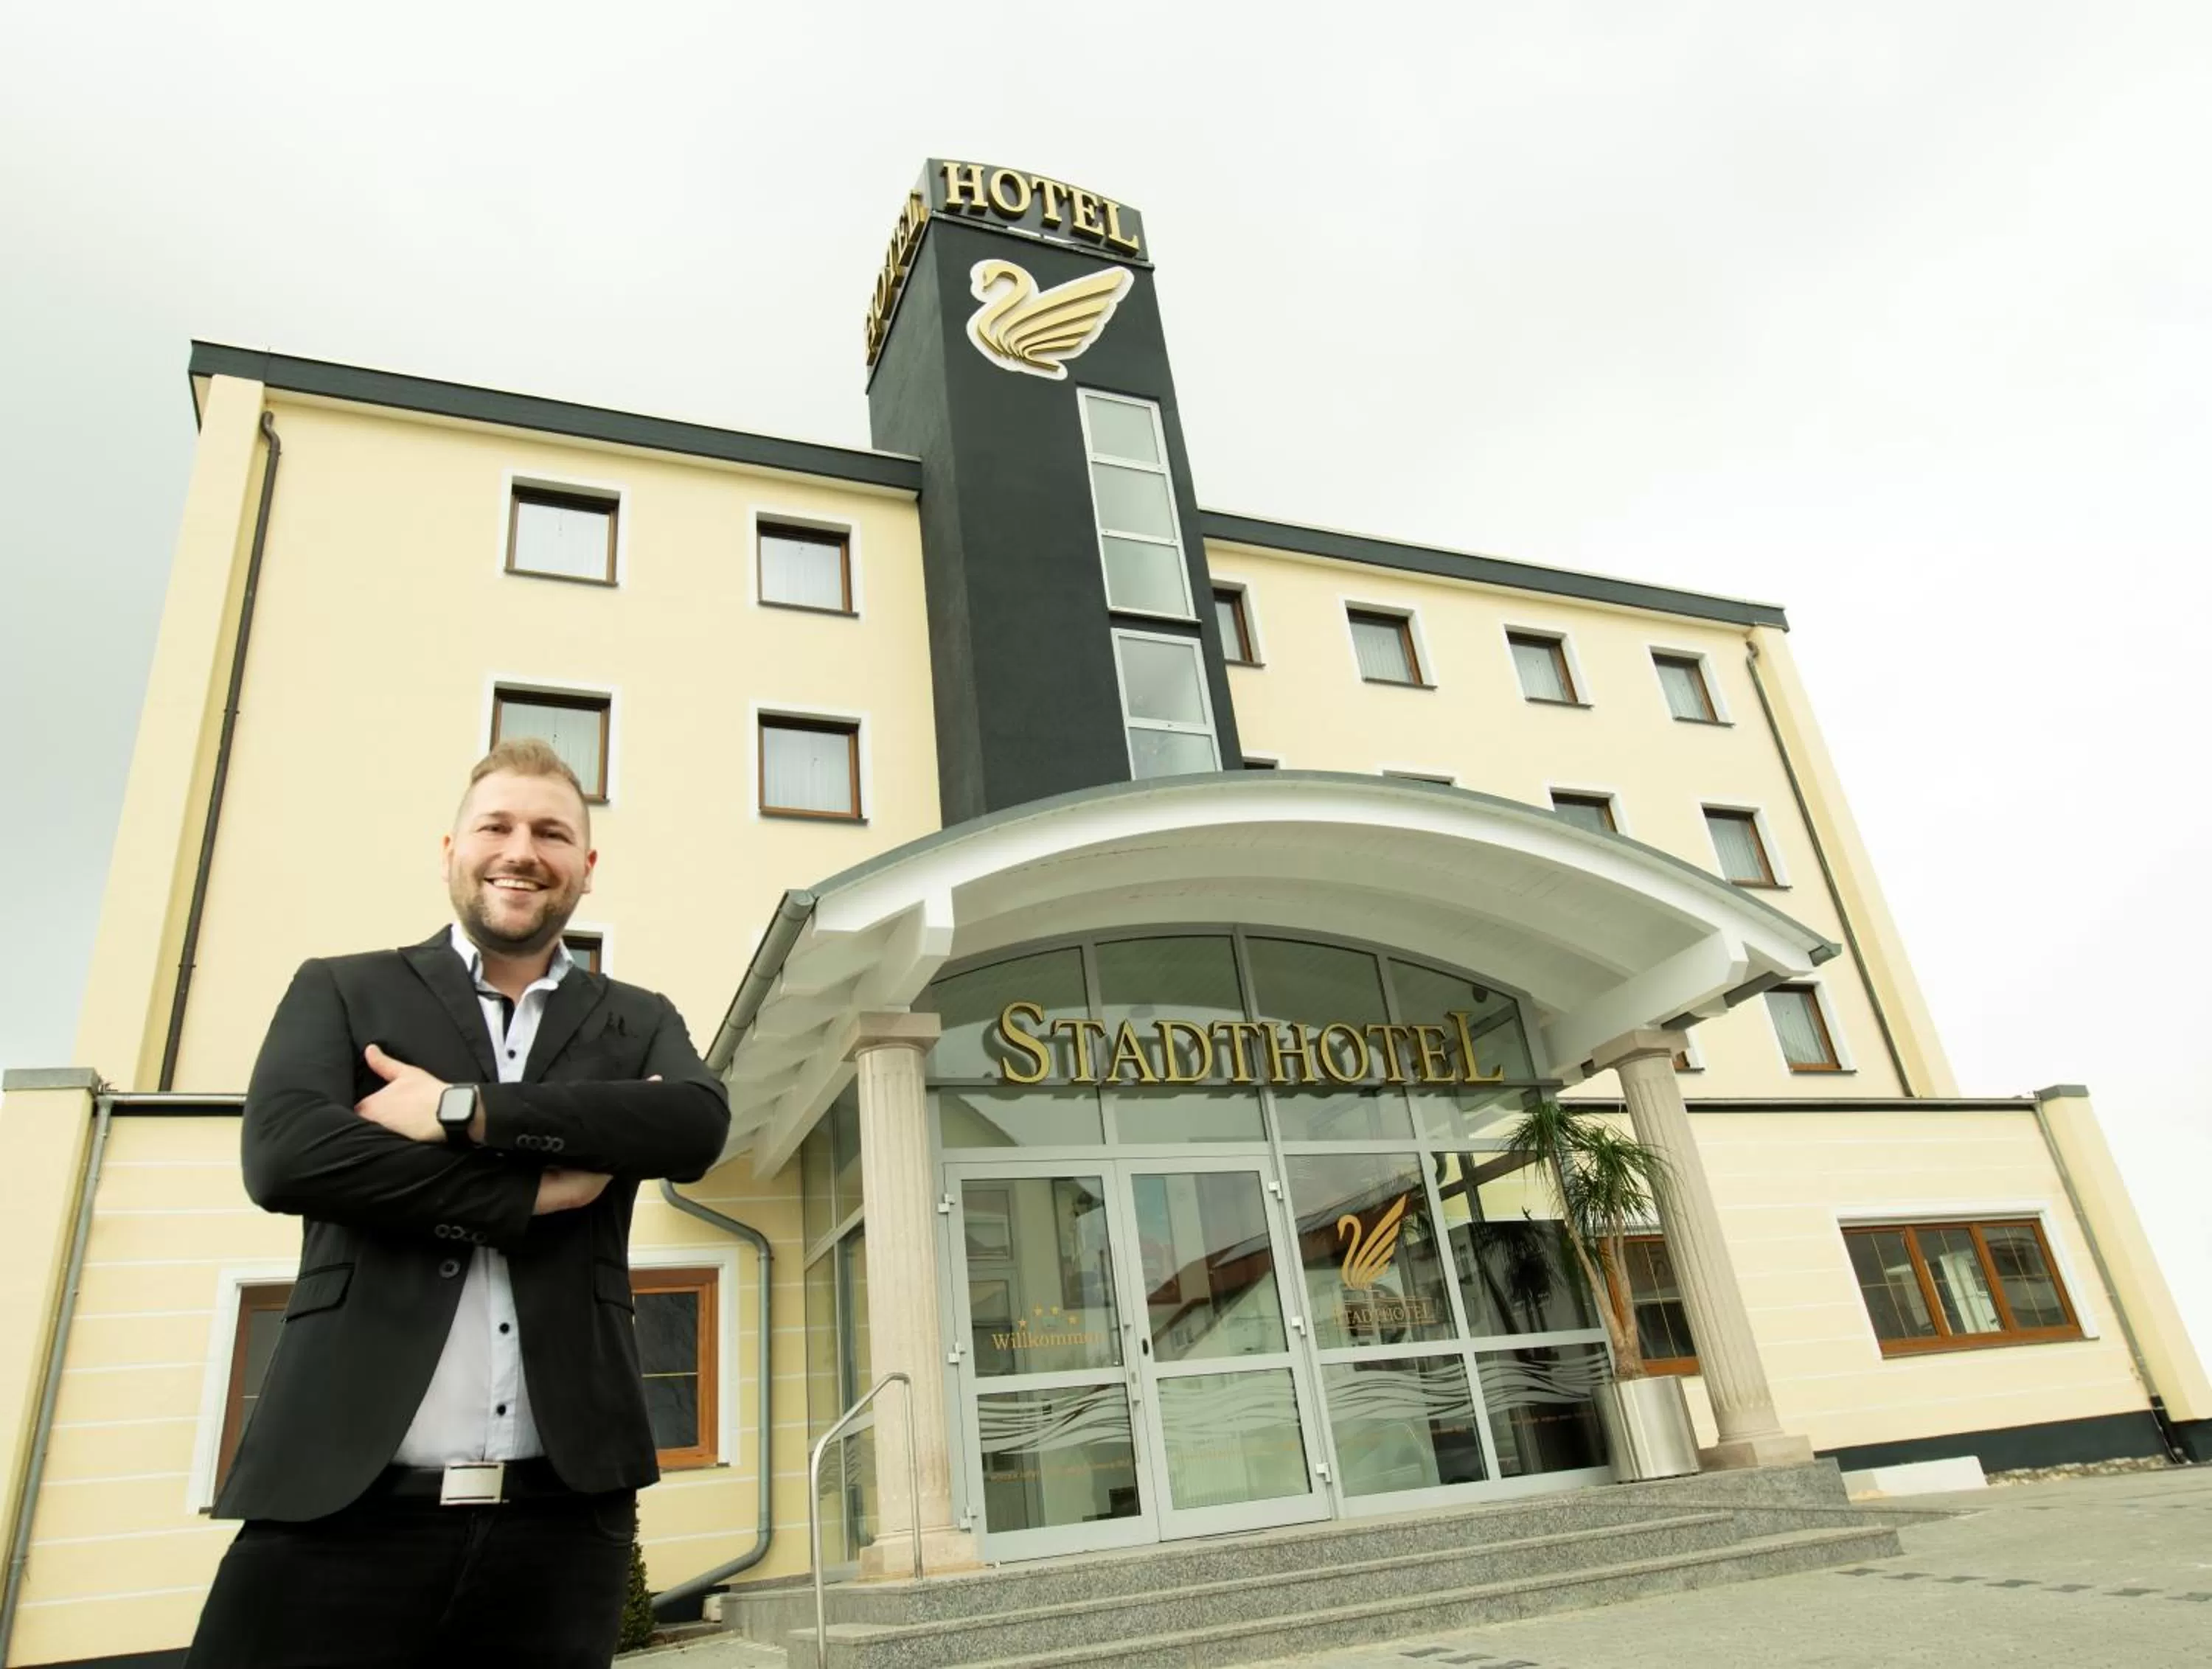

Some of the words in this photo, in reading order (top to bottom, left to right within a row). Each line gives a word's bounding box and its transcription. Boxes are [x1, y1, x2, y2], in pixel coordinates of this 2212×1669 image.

[940, 161, 1140, 257] HOTEL
[998, 1001, 1505, 1084] STADTHOTEL
[1333, 1301, 1433, 1325] TADHOTEL
